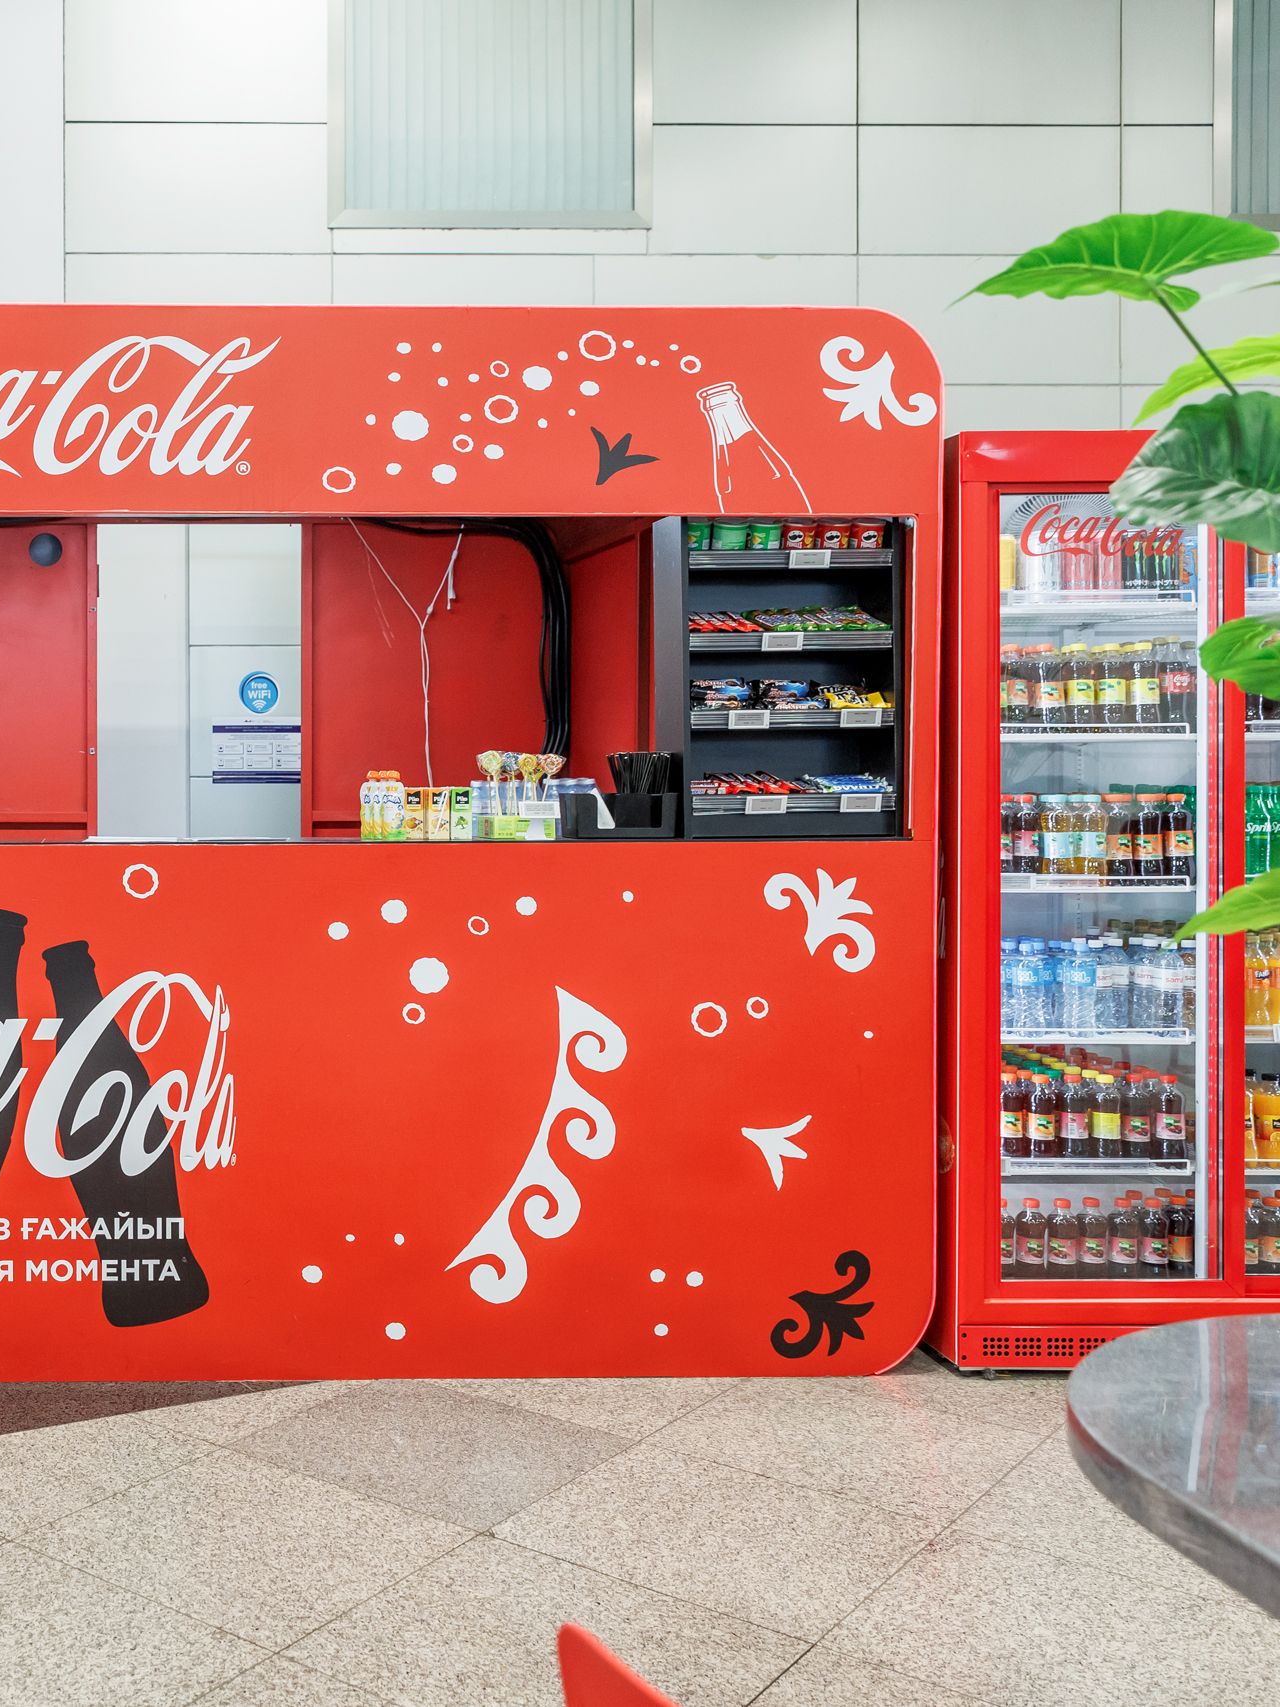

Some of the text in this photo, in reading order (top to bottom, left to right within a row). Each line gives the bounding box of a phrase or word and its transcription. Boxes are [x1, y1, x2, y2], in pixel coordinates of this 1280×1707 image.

[247, 690, 271, 699] WiFi
[20, 1212, 185, 1241] ҒАЖАЙЫП
[25, 1258, 181, 1283] МОМЕНТА
